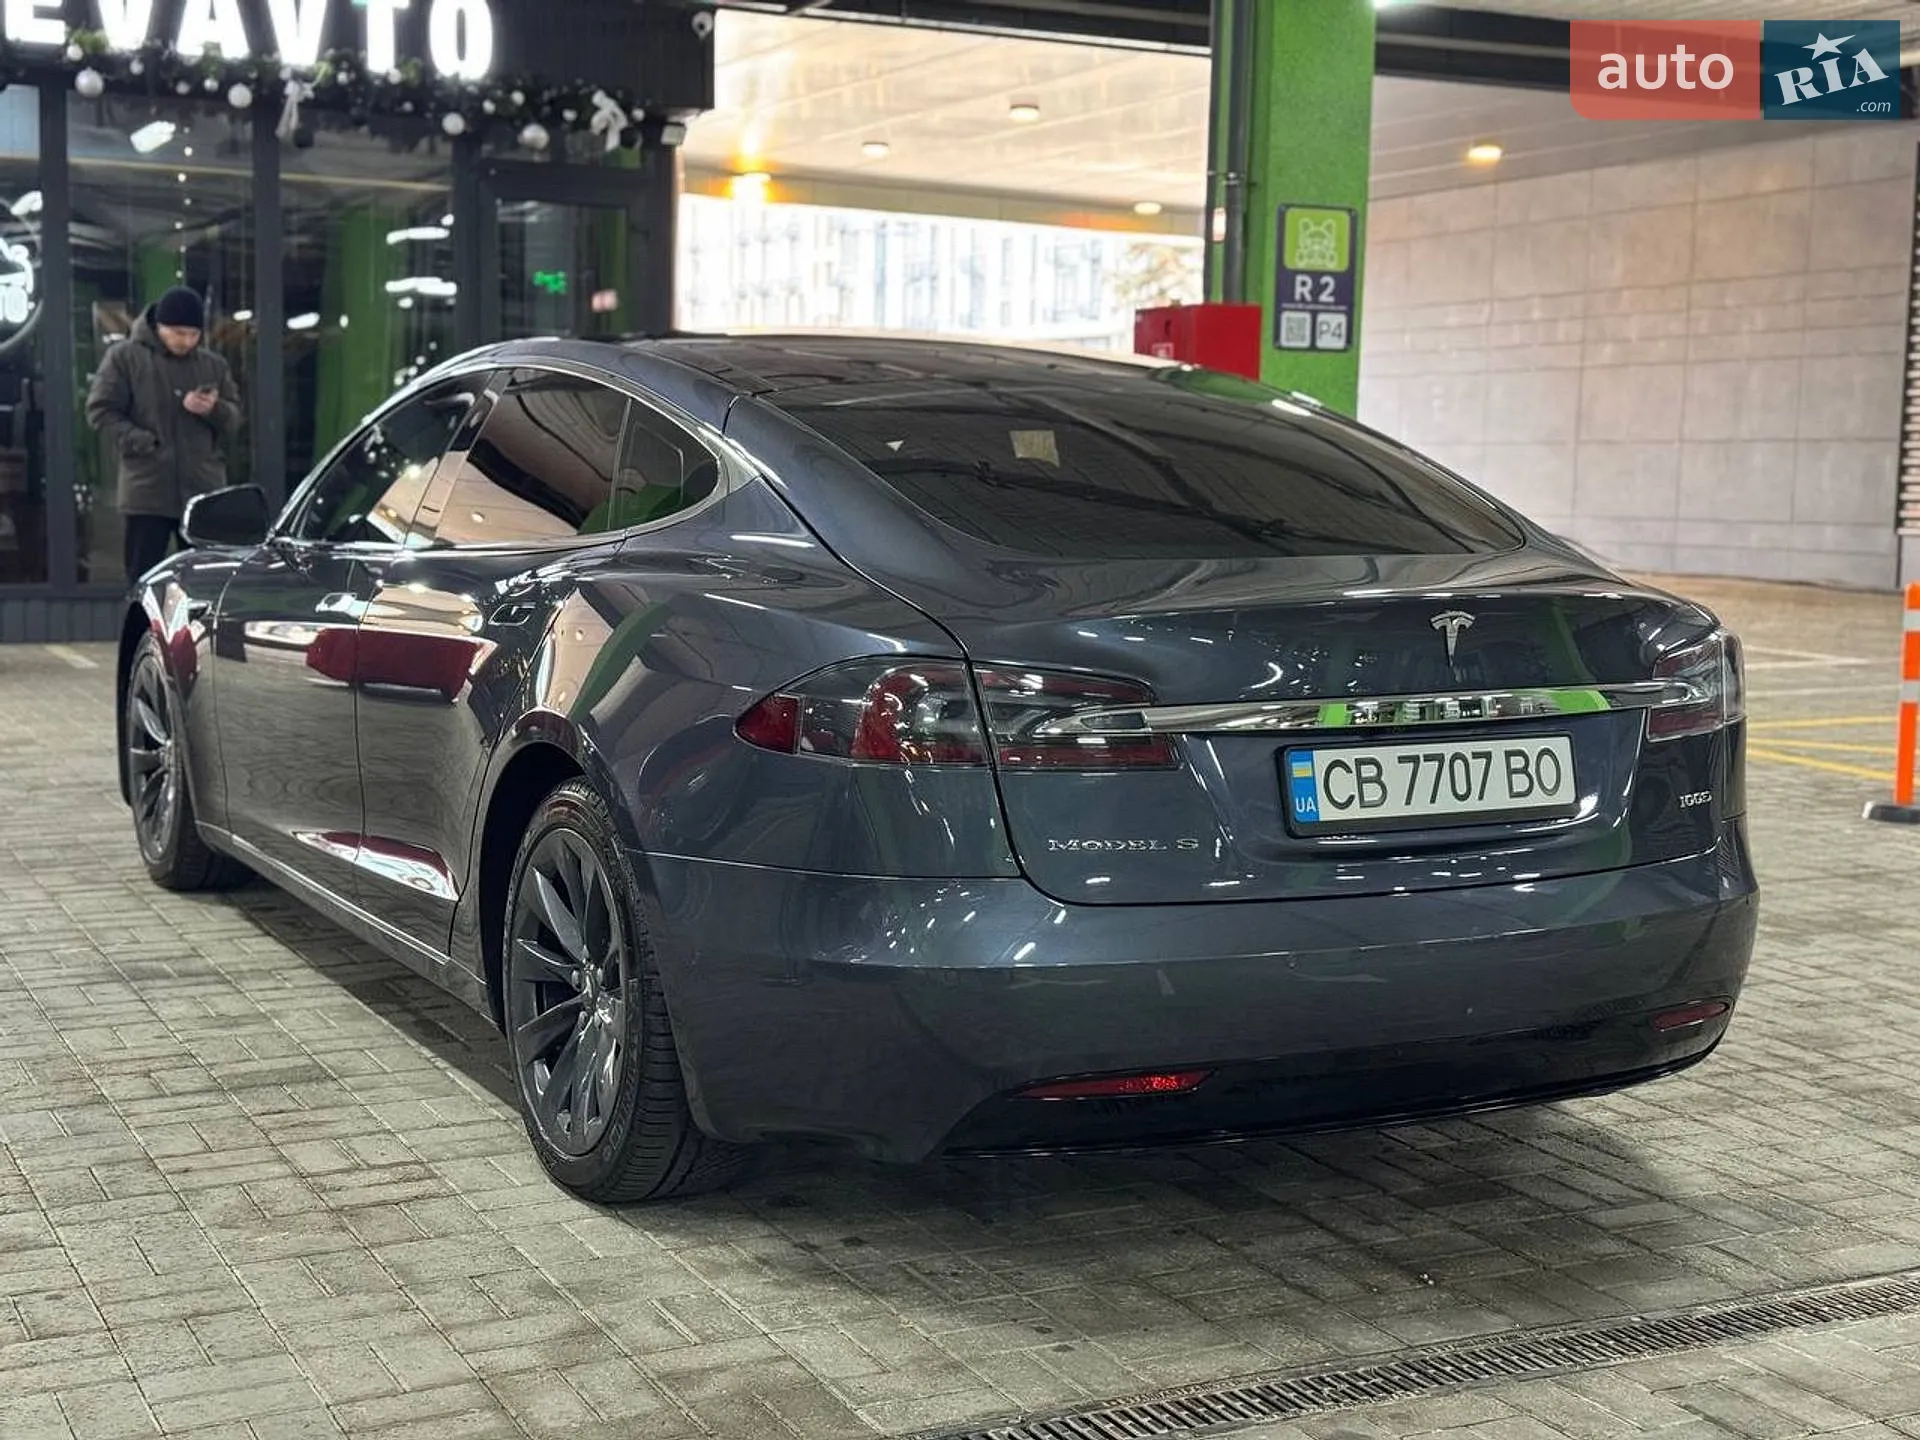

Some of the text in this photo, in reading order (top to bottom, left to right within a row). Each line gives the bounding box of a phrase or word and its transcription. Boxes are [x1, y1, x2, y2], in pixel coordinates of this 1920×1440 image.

[1294, 274, 1336, 302] R 2
[1318, 320, 1343, 340] P4
[1322, 746, 1562, 810] CB 7707 BO
[1295, 797, 1317, 814] UA
[1048, 838, 1199, 851] MODEL S
